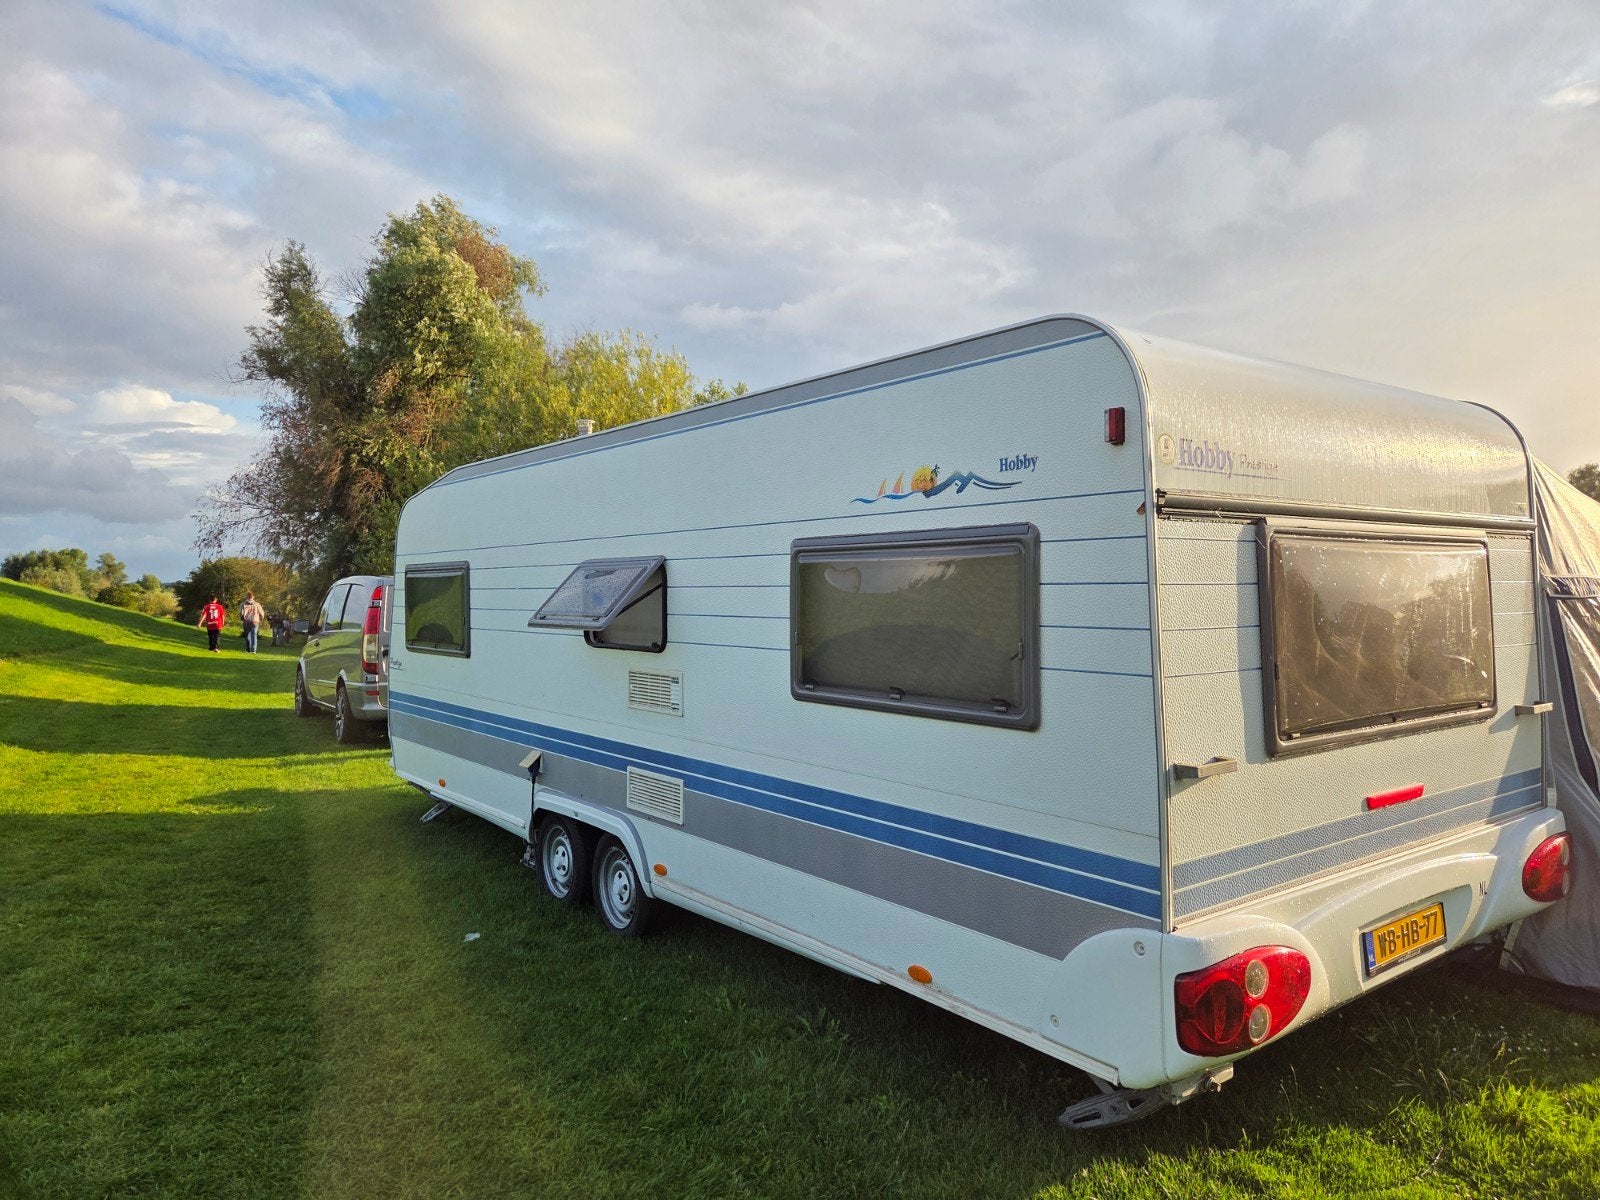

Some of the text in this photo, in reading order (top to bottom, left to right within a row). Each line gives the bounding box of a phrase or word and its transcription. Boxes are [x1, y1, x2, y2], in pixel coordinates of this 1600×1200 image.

[999, 453, 1038, 472] Hobby
[1178, 437, 1236, 478] Hobby
[1479, 880, 1488, 896] NL
[1378, 911, 1438, 958] WB-HB-77
